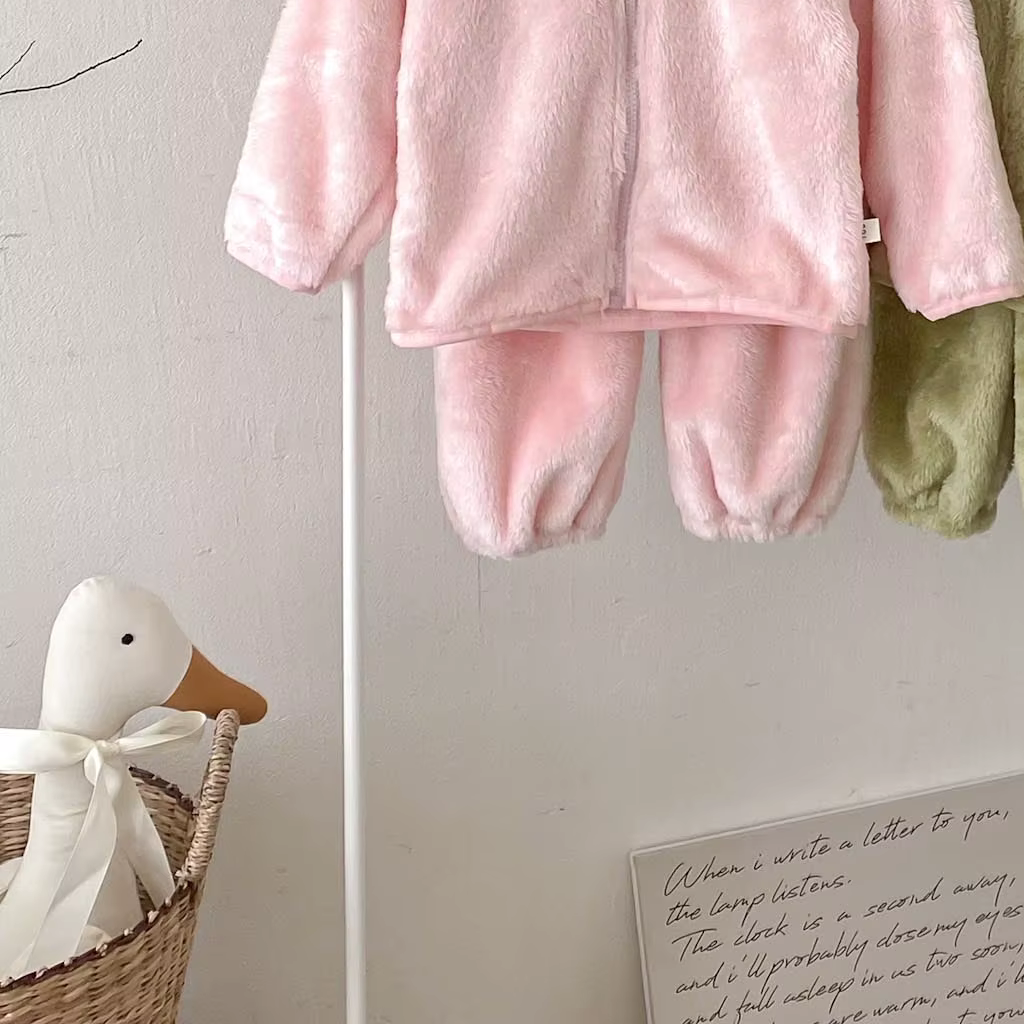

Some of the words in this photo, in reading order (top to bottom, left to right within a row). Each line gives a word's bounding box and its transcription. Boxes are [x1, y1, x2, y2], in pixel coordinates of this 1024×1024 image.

[664, 856, 744, 896] When
[754, 853, 763, 870] i
[774, 834, 831, 864] write
[839, 840, 853, 850] a
[863, 816, 924, 847] letter
[931, 807, 954, 832] to
[963, 809, 1008, 841] you,
[666, 898, 701, 925] the
[709, 892, 765, 927] lamp
[772, 874, 851, 903] listens.
[672, 928, 723, 962] The
[734, 913, 788, 946] clock
[803, 914, 823, 931] is
[837, 911, 851, 921] a
[864, 877, 943, 917] second
[953, 874, 1016, 907] away,
[676, 962, 724, 994] and
[760, 930, 868, 994] probably
[876, 922, 932, 948] close
[933, 917, 968, 947] my
[975, 905, 1024, 940] eyes
[682, 995, 728, 1024] and
[736, 985, 778, 1024] fall
[783, 976, 854, 1014] asleep
[861, 969, 884, 986] in
[926, 948, 963, 972] two
[971, 942, 1023, 960] soon,
[873, 996, 936, 1017] warm,
[947, 968, 994, 999] and
